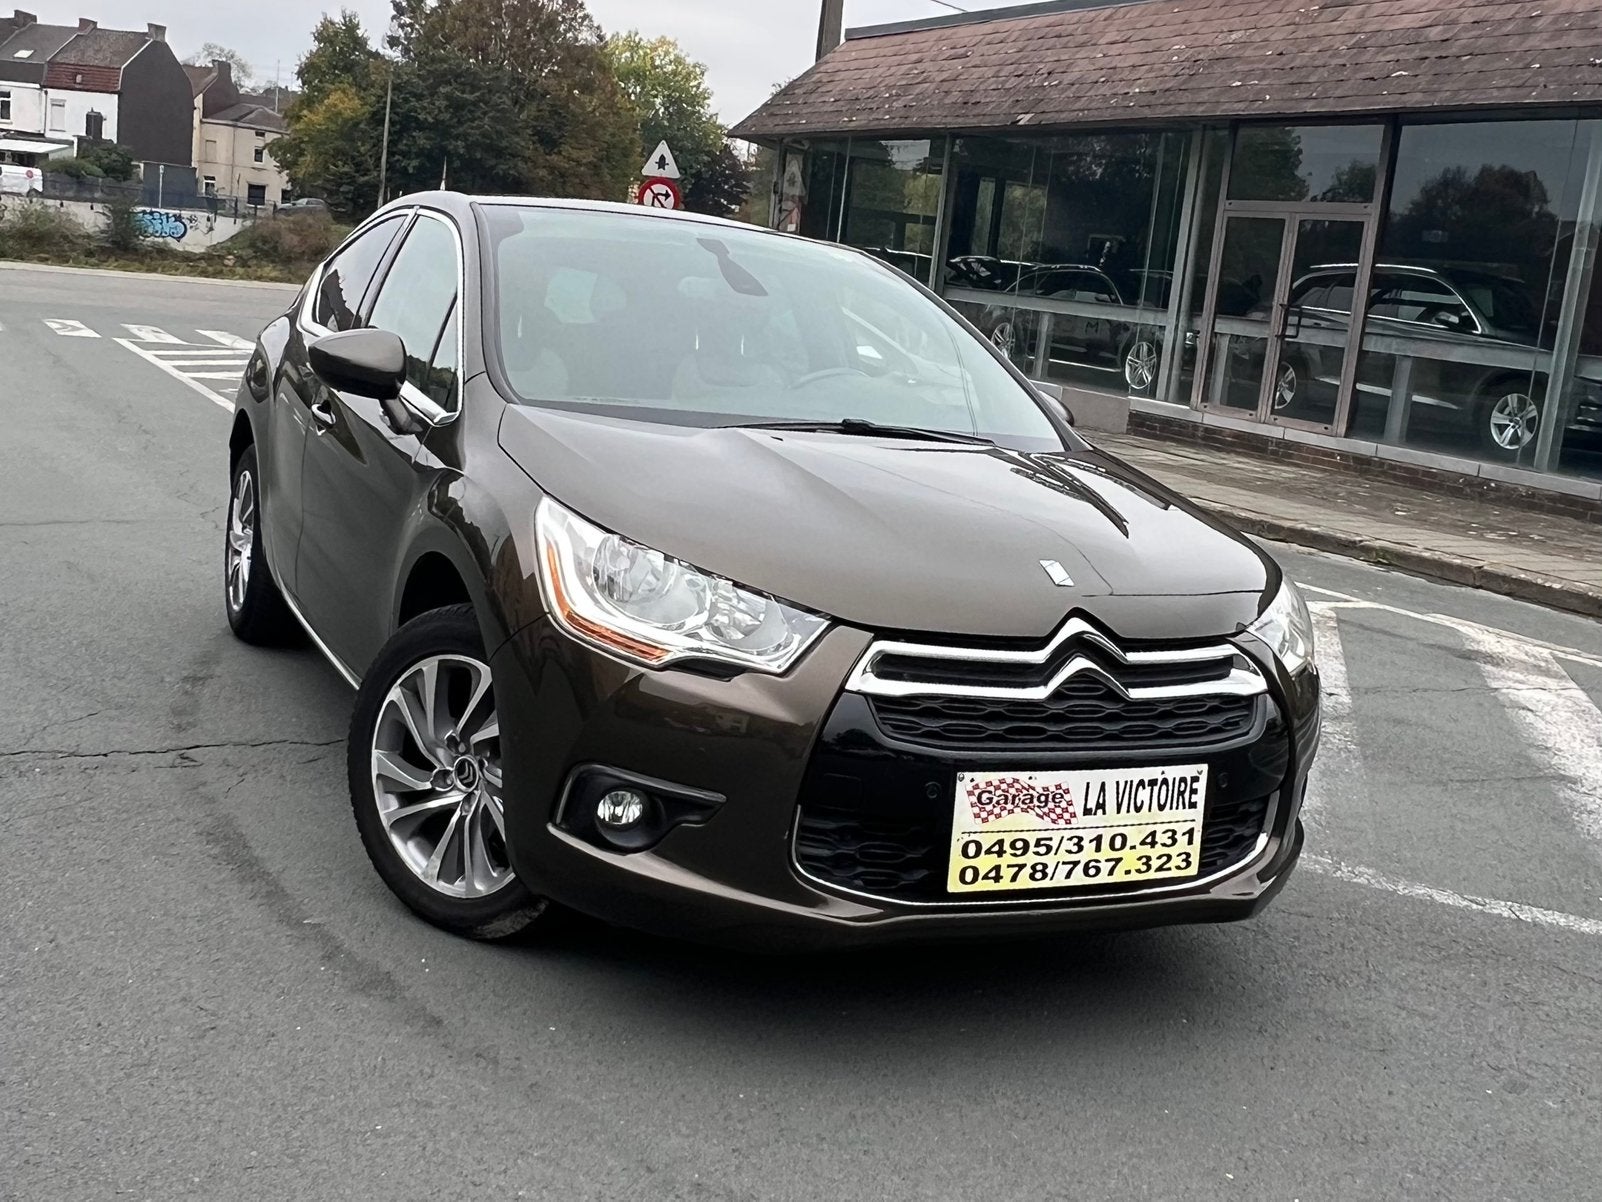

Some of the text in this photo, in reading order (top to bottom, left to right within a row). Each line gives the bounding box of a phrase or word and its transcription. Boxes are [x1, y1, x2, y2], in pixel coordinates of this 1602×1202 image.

[977, 776, 1200, 816] Garage LA VICTOIRE
[961, 827, 1195, 860] 0495/310.431
[958, 852, 1193, 886] 0478/767.323
